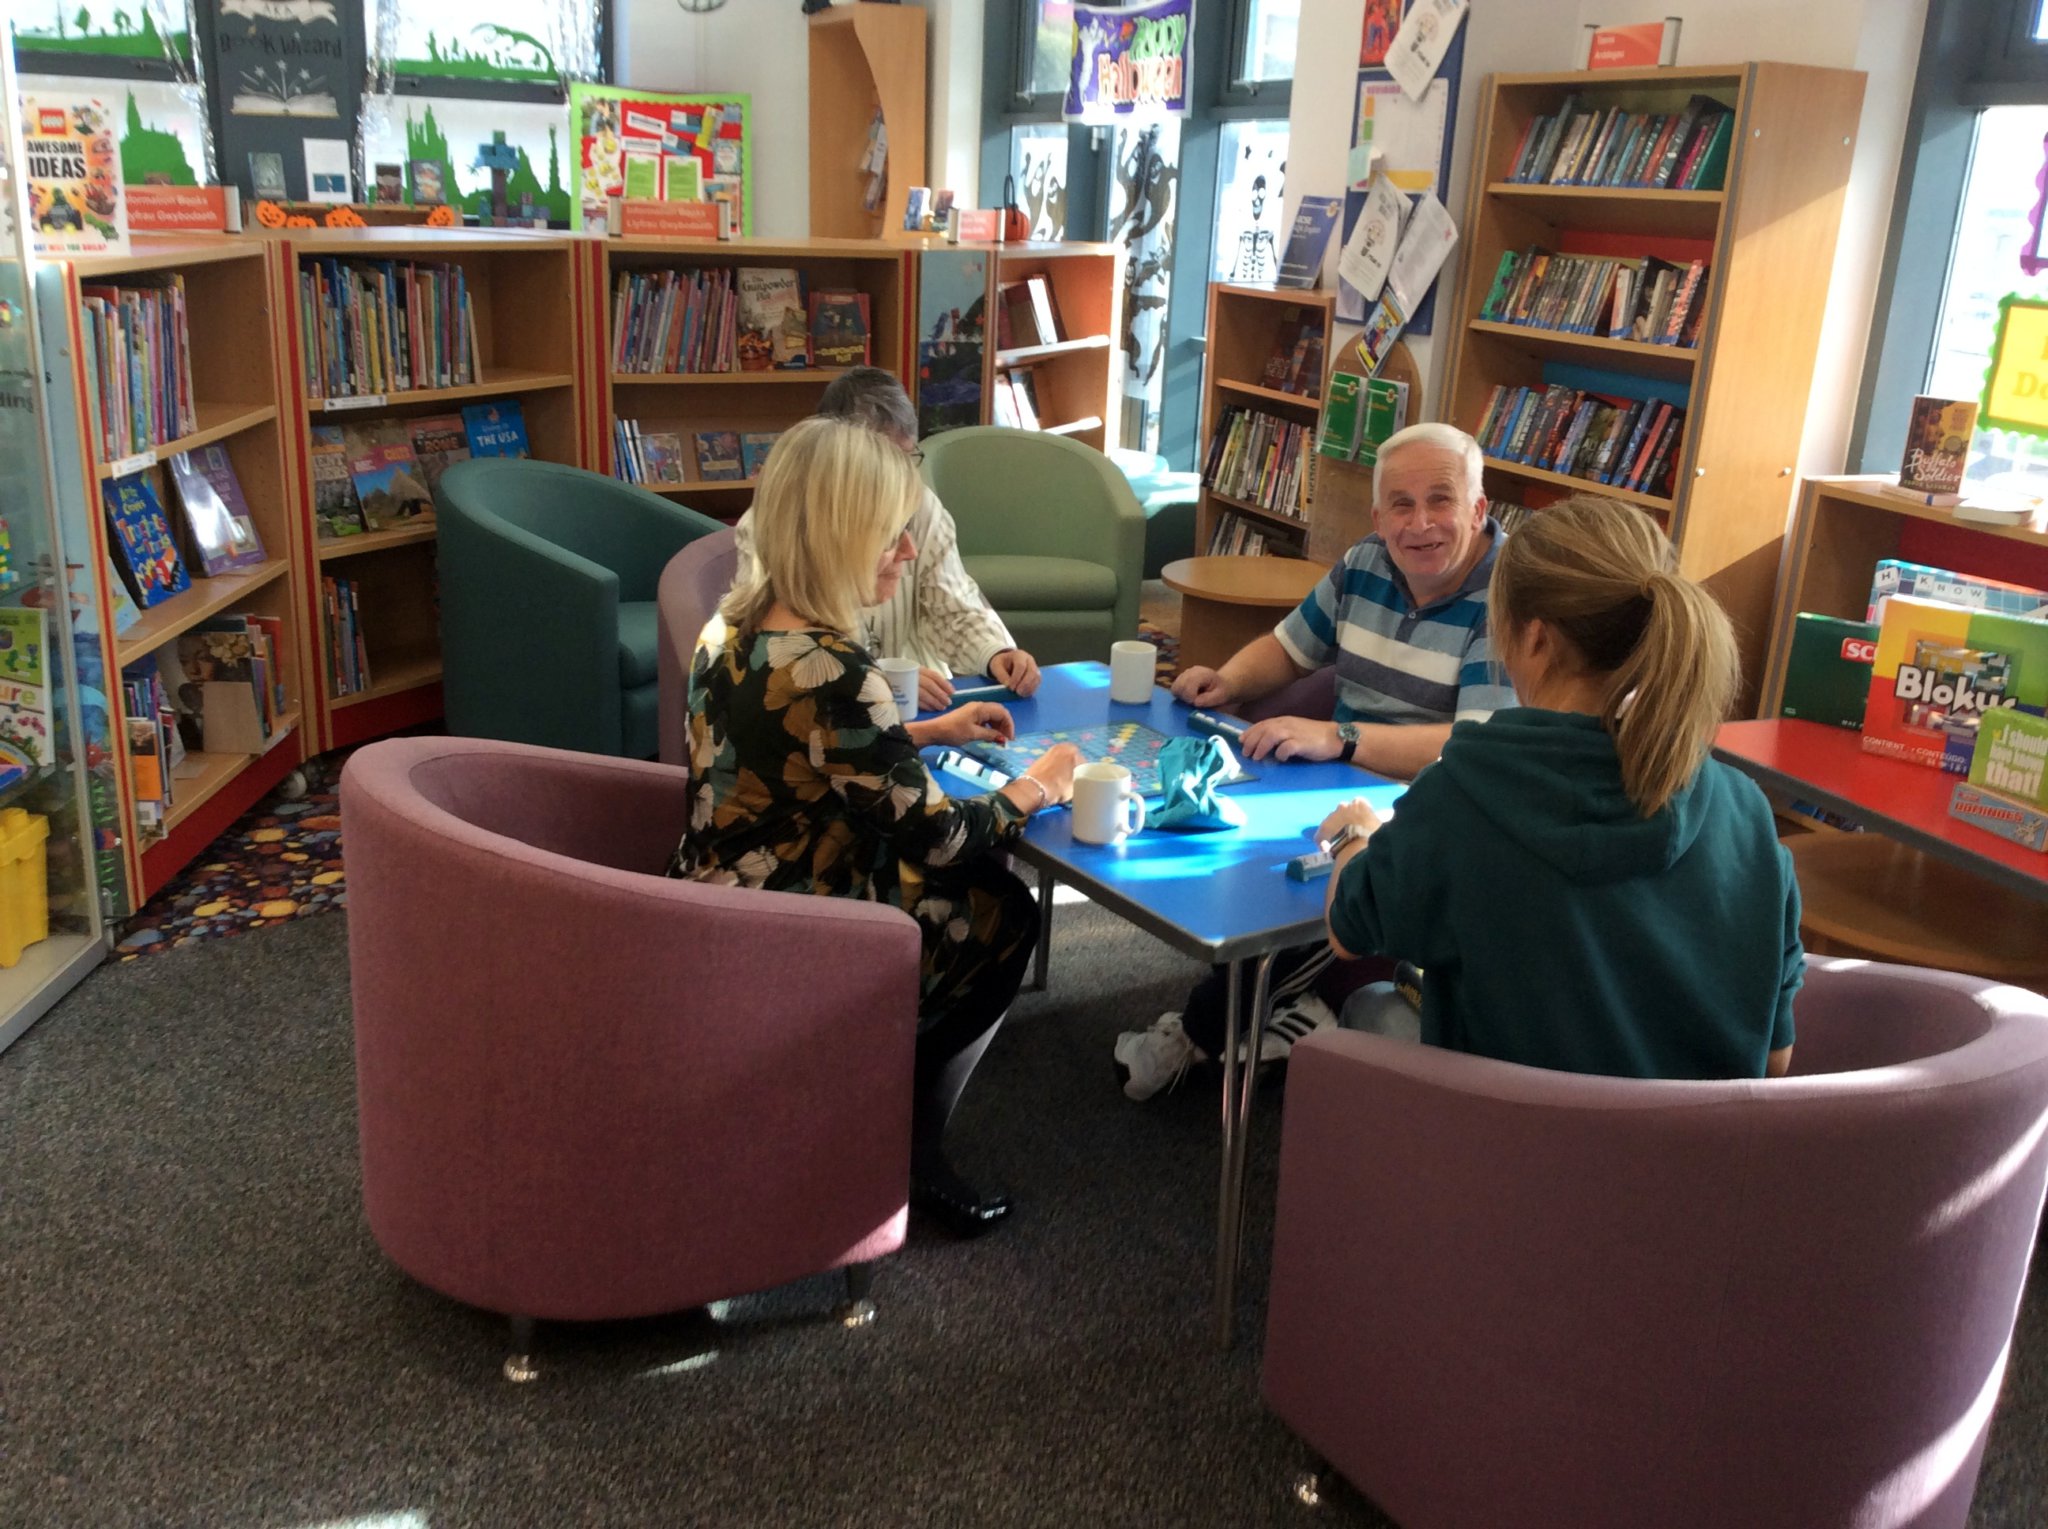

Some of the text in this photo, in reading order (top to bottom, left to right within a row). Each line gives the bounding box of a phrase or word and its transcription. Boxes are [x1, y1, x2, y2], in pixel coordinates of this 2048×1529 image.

[280, 35, 343, 58] Wizard
[1130, 14, 1186, 61] Happy
[1097, 52, 1182, 104] Halloween
[41, 114, 65, 128] LEGO
[27, 140, 84, 154] AWESOME
[28, 156, 87, 178] IDEAS
[742, 278, 795, 292] Gunpowder
[476, 430, 519, 447] THE USA
[1905, 448, 1957, 472] Buffalo
[1913, 464, 1962, 482] Soldier
[1847, 641, 1877, 662] SC
